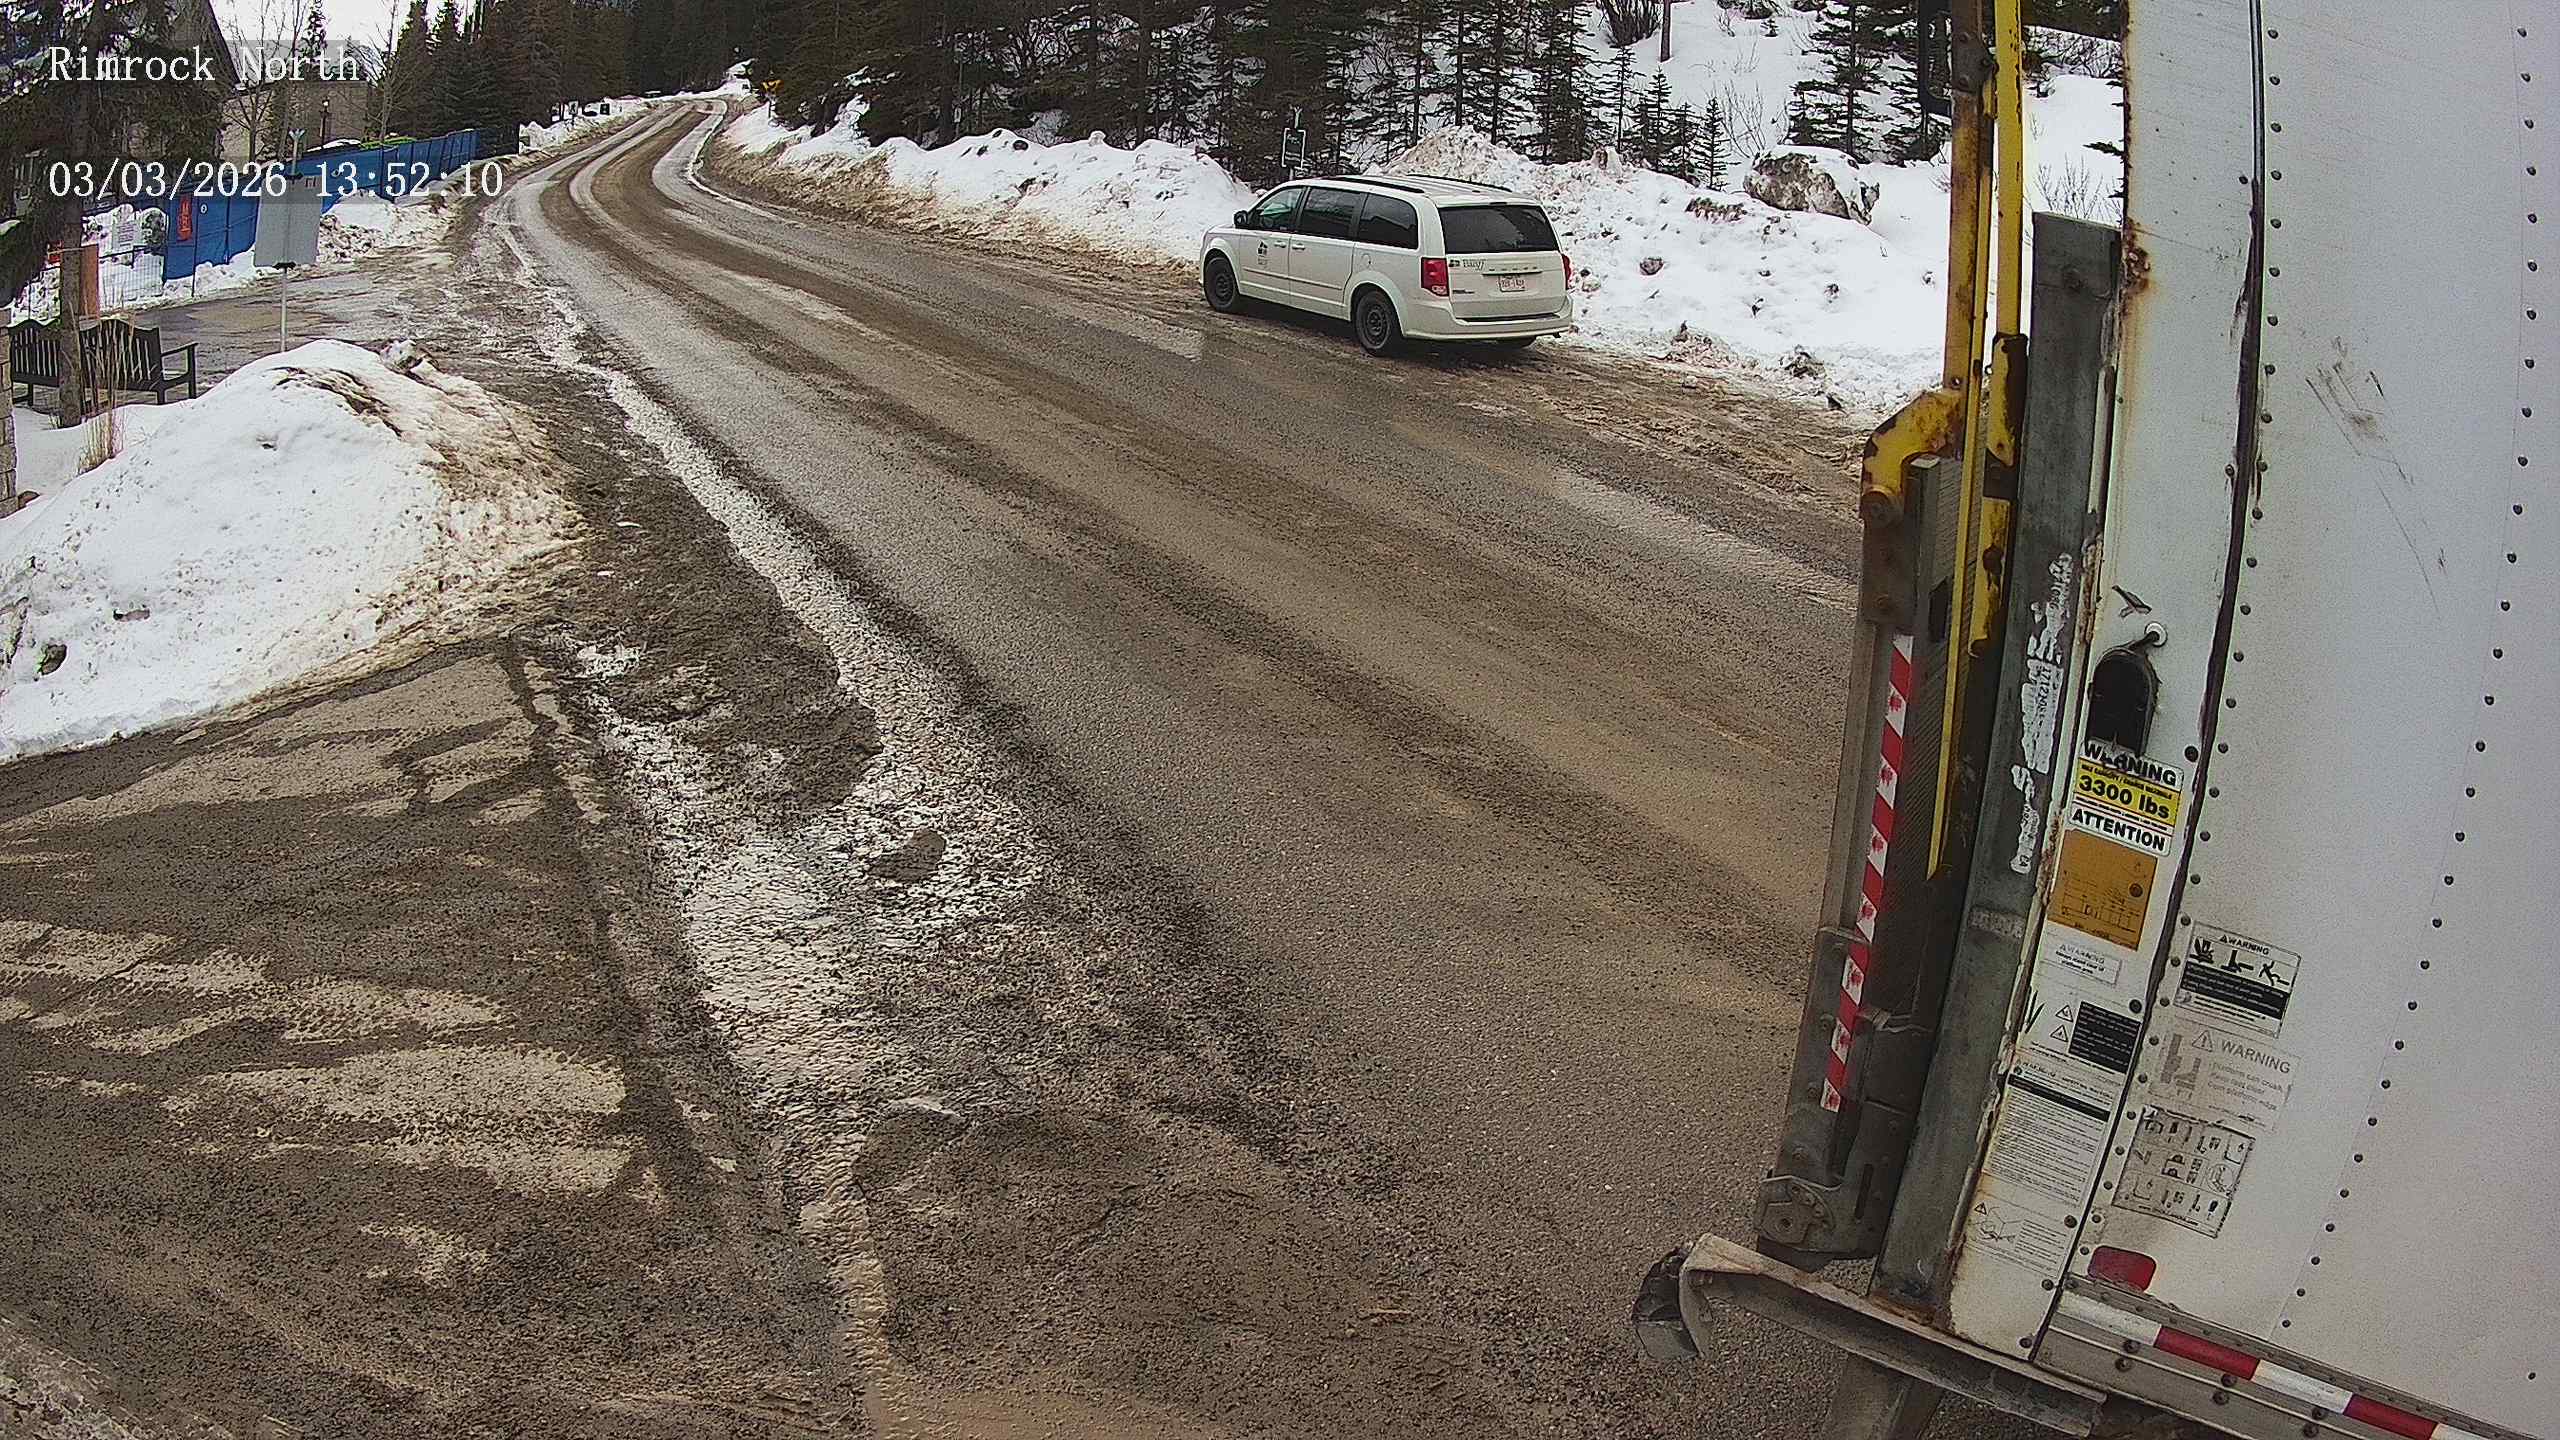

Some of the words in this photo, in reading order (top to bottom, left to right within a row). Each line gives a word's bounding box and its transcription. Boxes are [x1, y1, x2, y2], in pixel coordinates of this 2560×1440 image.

[2079, 775, 2132, 805] 3300
[2138, 794, 2170, 819] lbs
[2072, 808, 2166, 851] ATTENTION
[2228, 938, 2270, 956] WARNING
[2221, 1040, 2291, 1074] WARNING
